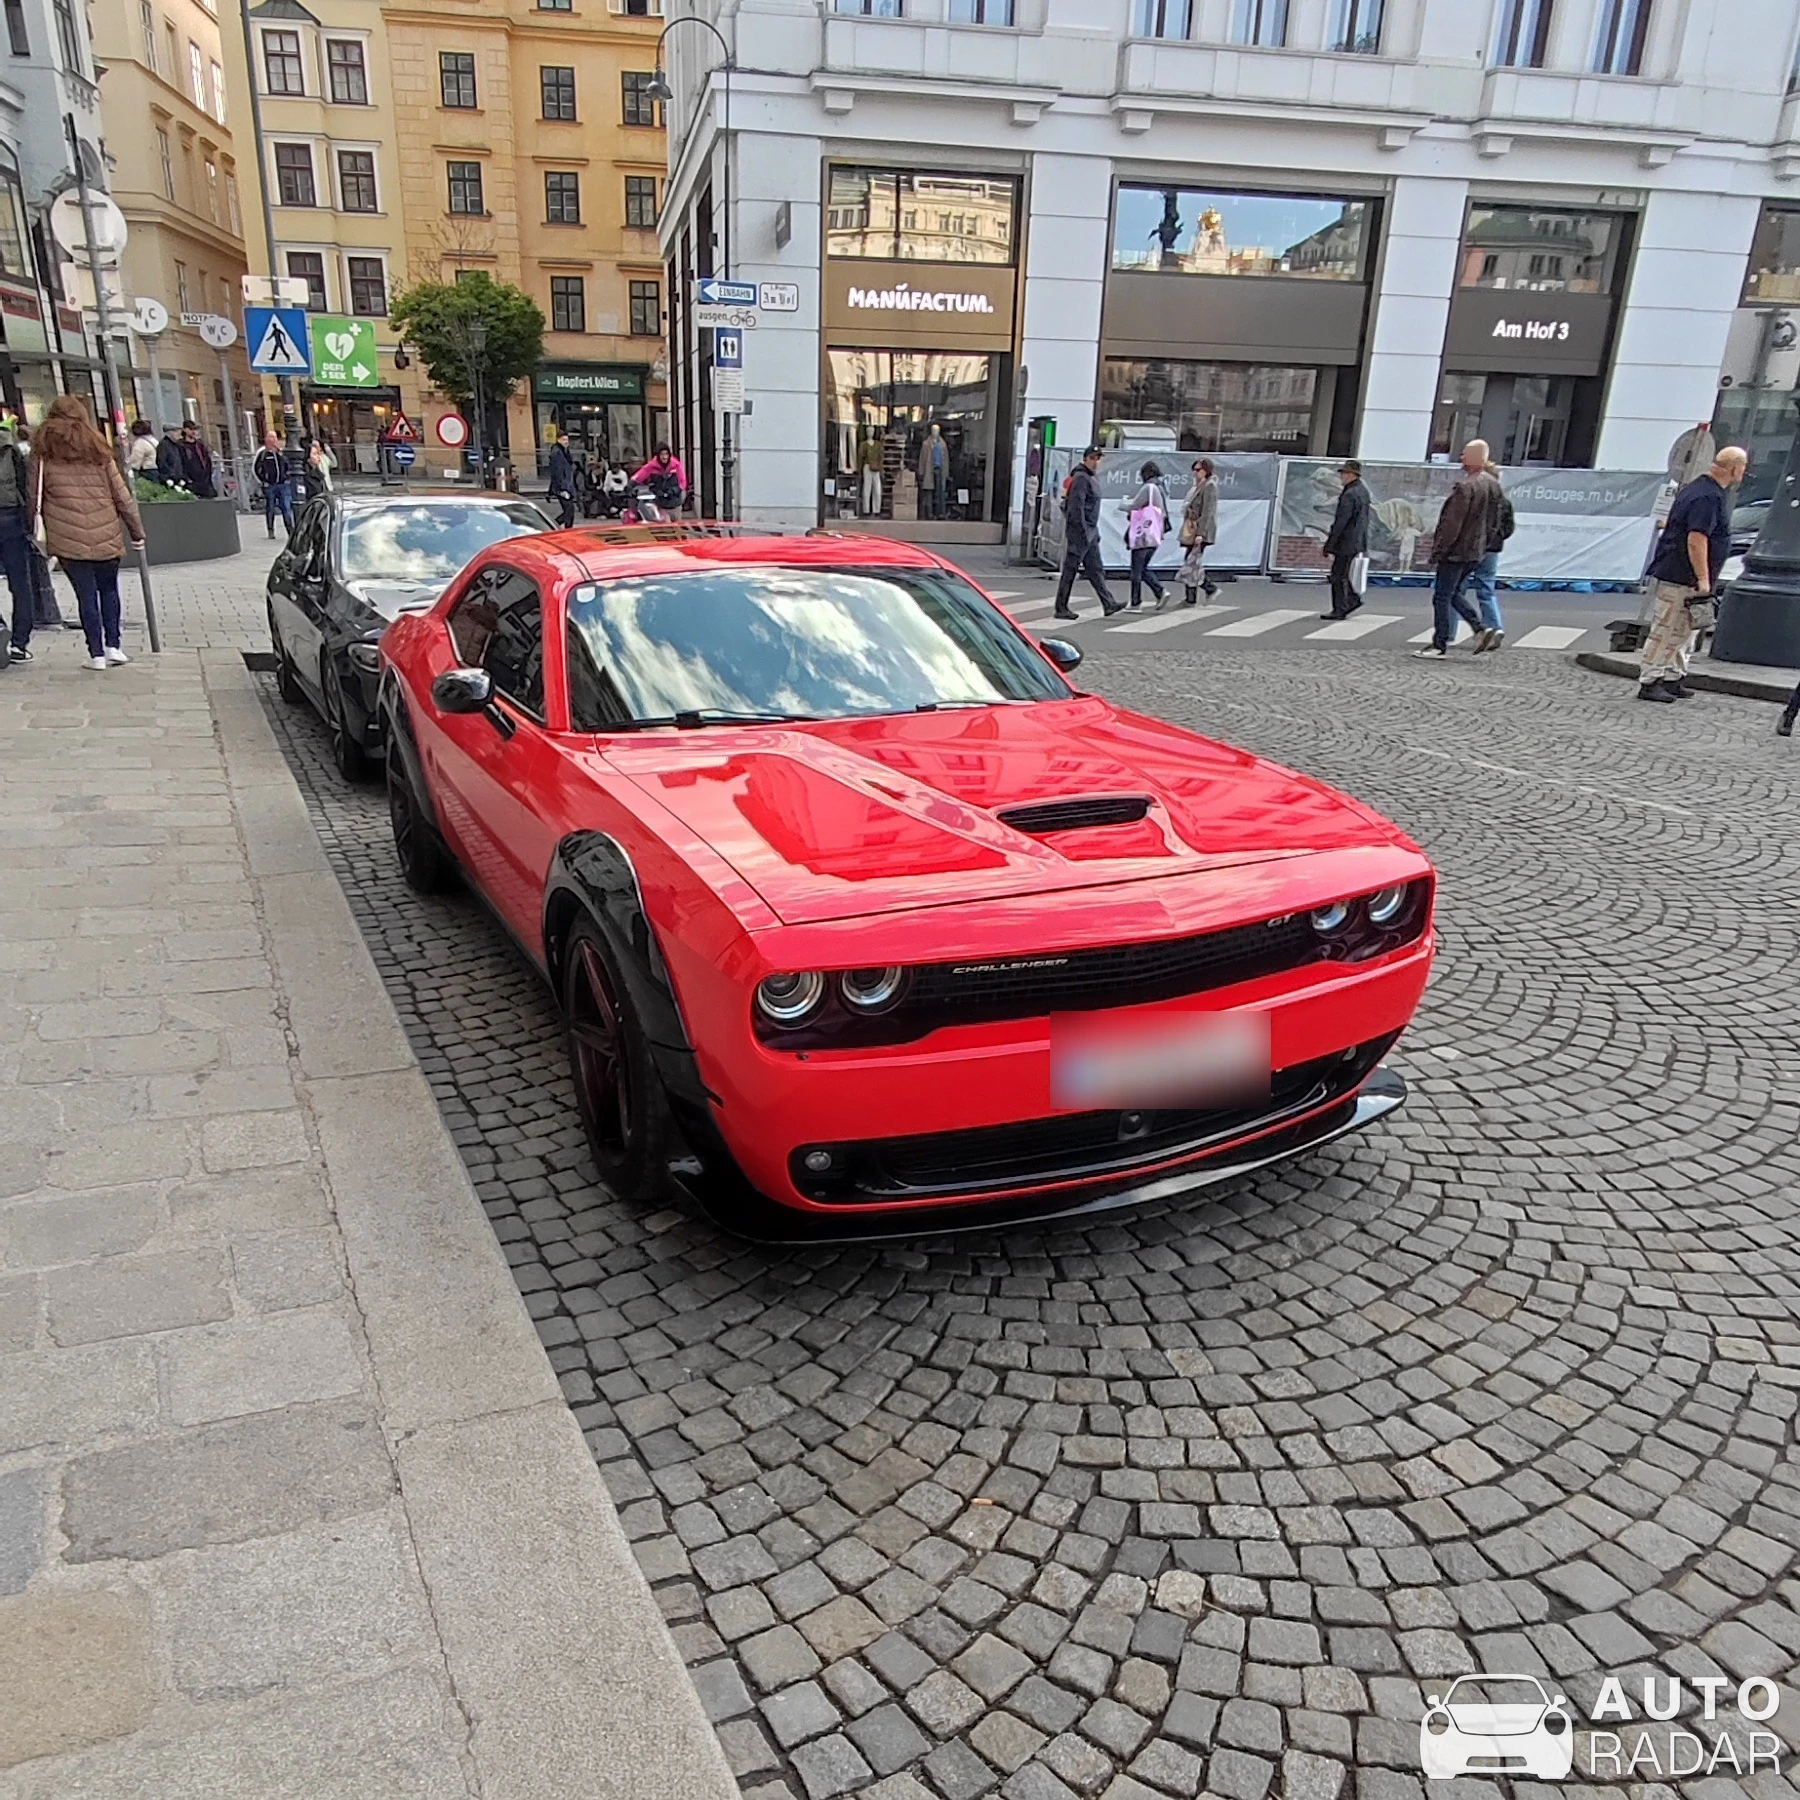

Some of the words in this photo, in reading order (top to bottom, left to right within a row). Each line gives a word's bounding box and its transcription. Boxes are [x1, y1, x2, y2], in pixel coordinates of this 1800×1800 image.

[719, 287, 751, 299] EINBAHN
[698, 311, 729, 322] ausgen.
[1492, 319, 1523, 338] Am
[1525, 320, 1558, 339] Hof
[1557, 321, 1570, 340] 3
[322, 362, 344, 371] DEFI
[1106, 470, 1131, 484] MH
[1508, 485, 1533, 499] MH
[1266, 913, 1297, 929] GT
[952, 958, 1069, 974] CHALLENGER
